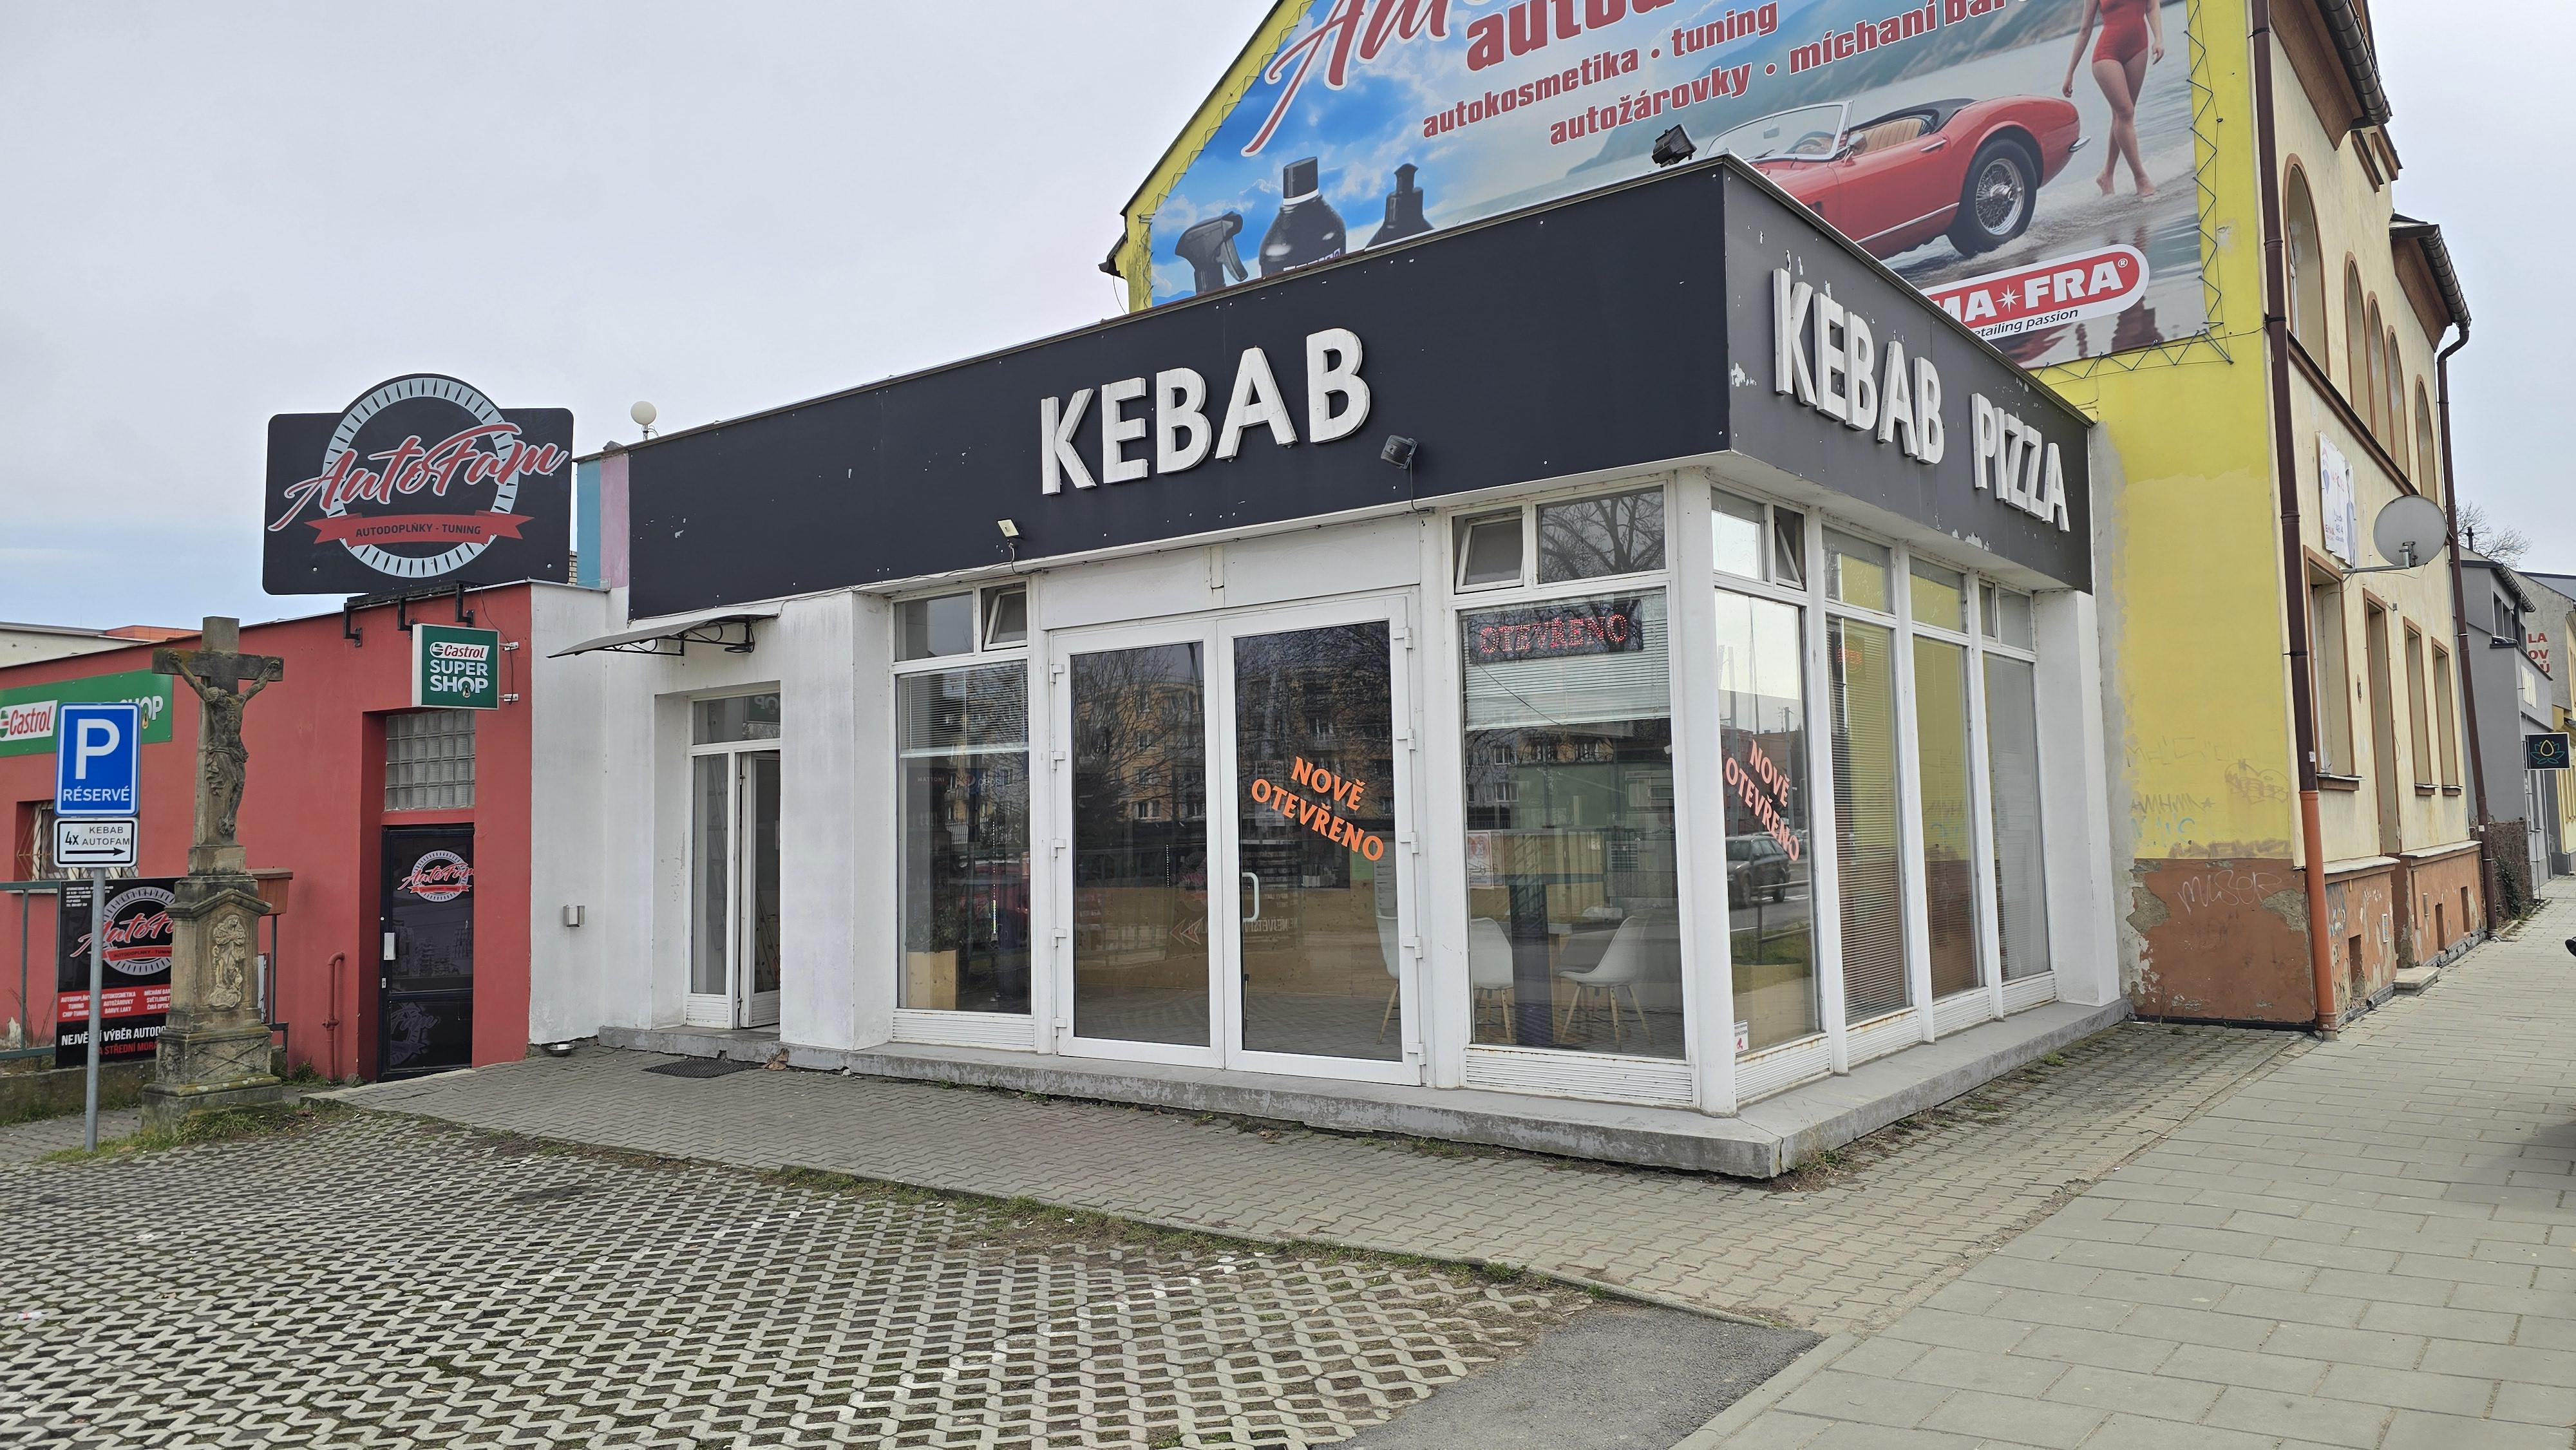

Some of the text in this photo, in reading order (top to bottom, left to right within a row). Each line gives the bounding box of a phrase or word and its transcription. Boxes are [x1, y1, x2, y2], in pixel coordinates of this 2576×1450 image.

[1423, 1, 1779, 138] autokosmetika tuning
[1550, 62, 1752, 146] autožárovky
[2027, 308, 2079, 329] passion
[1041, 327, 1370, 495] KEBAB
[1773, 268, 2070, 533] KEBAB PIZZA
[267, 422, 570, 532] AutoFam
[355, 522, 433, 538] AUTODOPLŇKY
[441, 523, 482, 535] TUNING
[444, 645, 485, 659] Castrol
[1479, 613, 1629, 654] OTEVŘENO
[430, 659, 489, 676] SUPER
[430, 675, 489, 695] SHOP
[9, 704, 53, 736] Castrol
[75, 718, 120, 780] P
[1750, 739, 1790, 807] NOVĚ
[62, 785, 130, 802] RÉSERVÉ
[1290, 756, 1366, 811] NOVĚ
[1251, 778, 1385, 862] OTEVŘENO
[1725, 757, 1800, 862] OTEVŘENO
[82, 838, 130, 846] AUTOFAM
[61, 1030, 102, 1046] NEJVĚÍ
[104, 1028, 133, 1042] VÝBĚR
